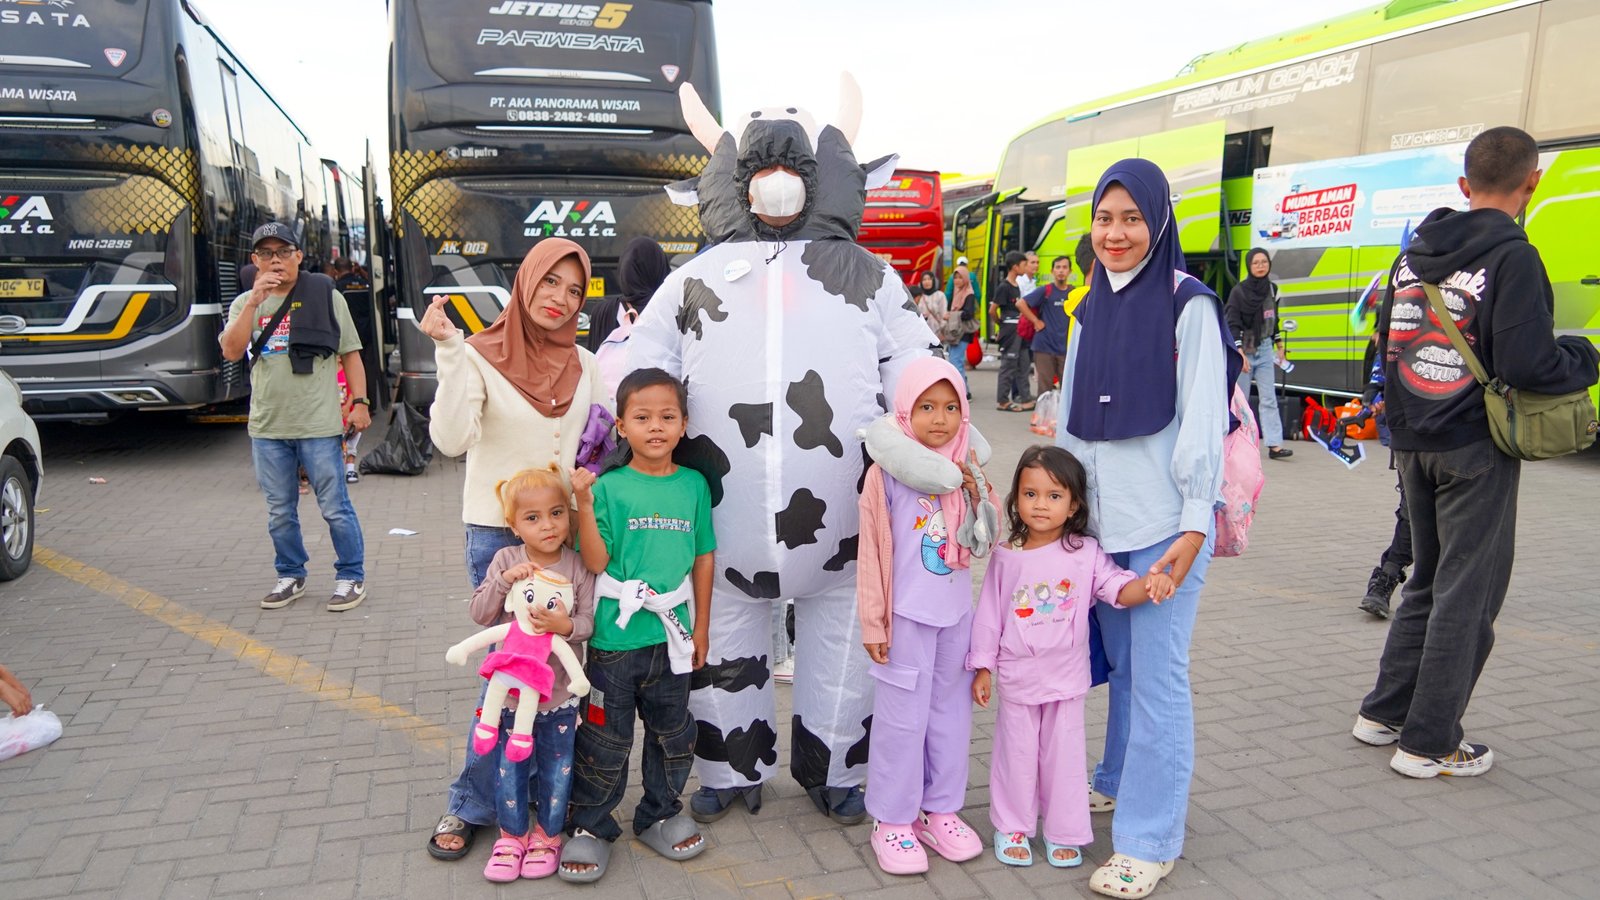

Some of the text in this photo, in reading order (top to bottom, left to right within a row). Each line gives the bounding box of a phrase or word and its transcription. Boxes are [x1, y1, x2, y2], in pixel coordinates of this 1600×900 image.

[477, 29, 645, 53] PARIWISATA
[1173, 52, 1359, 112] PREMIUM COACH
[0, 88, 77, 101] MA WISATA
[490, 98, 641, 111] PT. AKA PANORAMA WISATA
[1285, 186, 1353, 210] MUDIK AMAN
[523, 200, 616, 224] AKA
[1298, 204, 1355, 225] BERBAGI
[1297, 220, 1352, 238] HARAPAN
[0, 280, 41, 291] 04 YC
